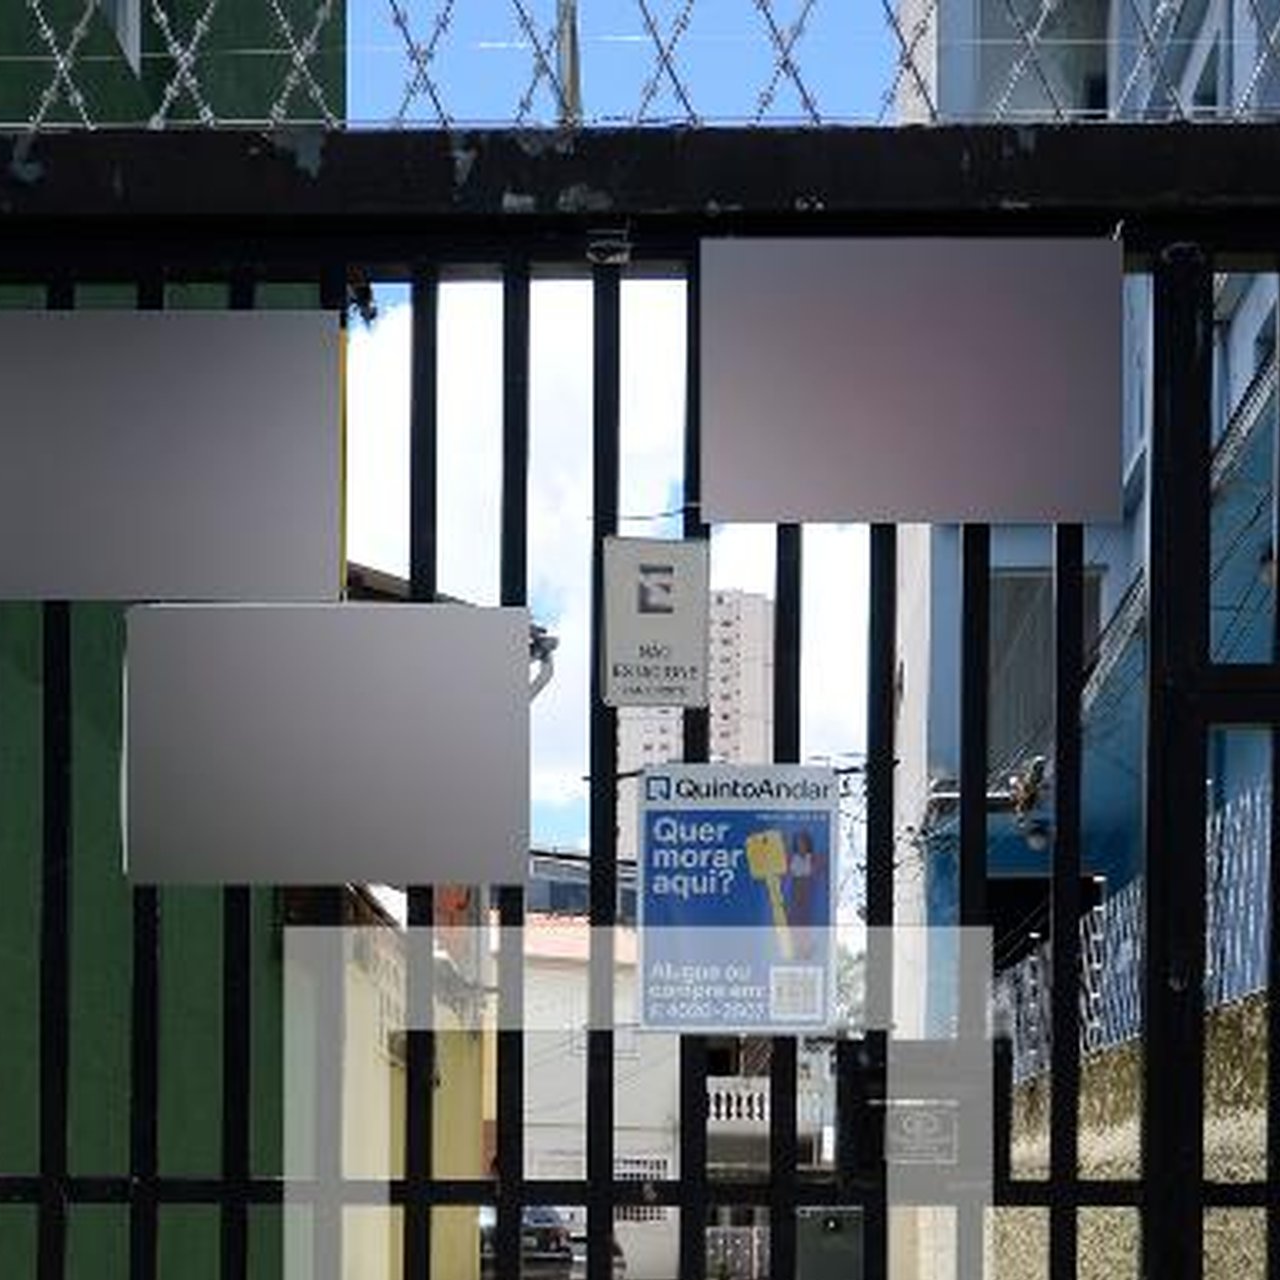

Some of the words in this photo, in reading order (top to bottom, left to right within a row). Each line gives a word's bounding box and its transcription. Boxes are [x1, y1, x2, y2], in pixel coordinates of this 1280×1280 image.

[675, 775, 835, 801] QuintoAndar
[652, 817, 730, 845] Quer
[652, 848, 743, 868] morar
[651, 869, 735, 899] aqui?
